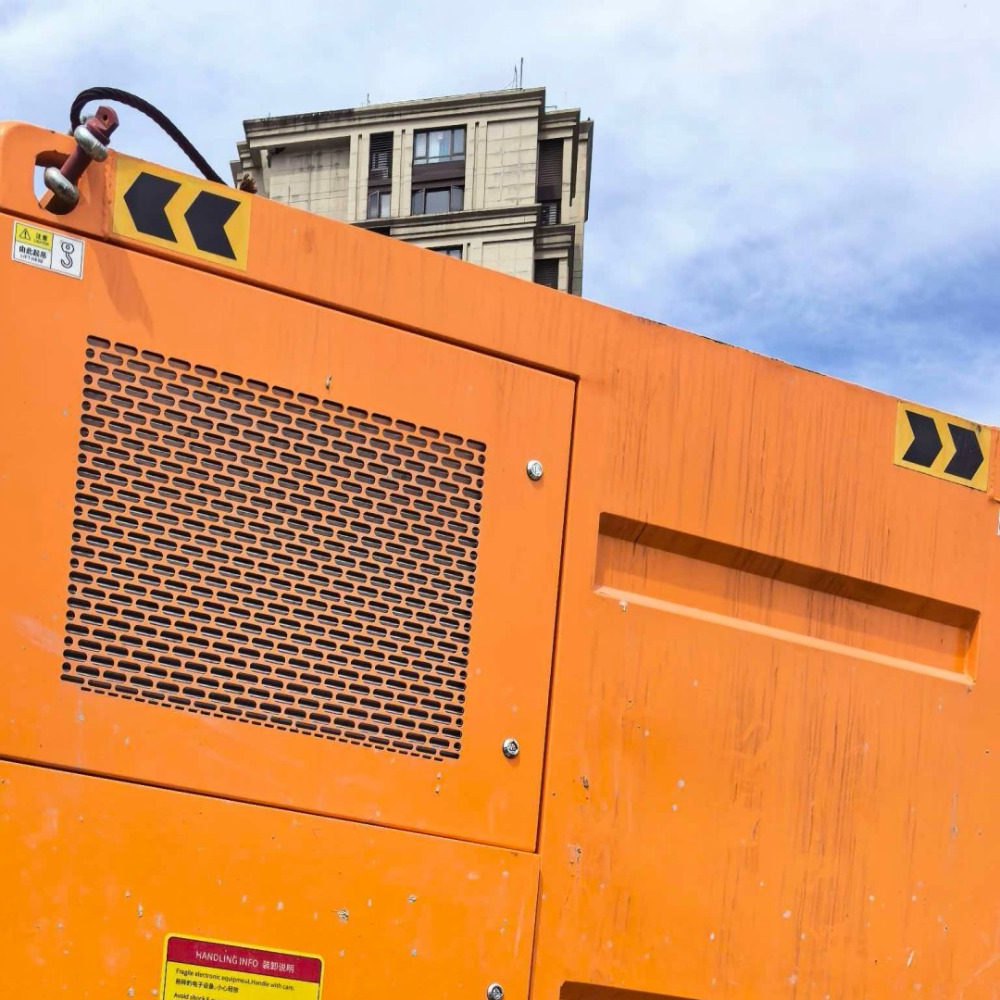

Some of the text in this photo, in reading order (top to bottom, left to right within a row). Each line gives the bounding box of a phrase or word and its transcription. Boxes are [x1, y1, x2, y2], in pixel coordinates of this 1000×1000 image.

[195, 950, 258, 968] HANDLING INFO
[175, 967, 193, 977] Fragile
[194, 971, 220, 979] electronic
[262, 960, 294, 973] 装卸说明
